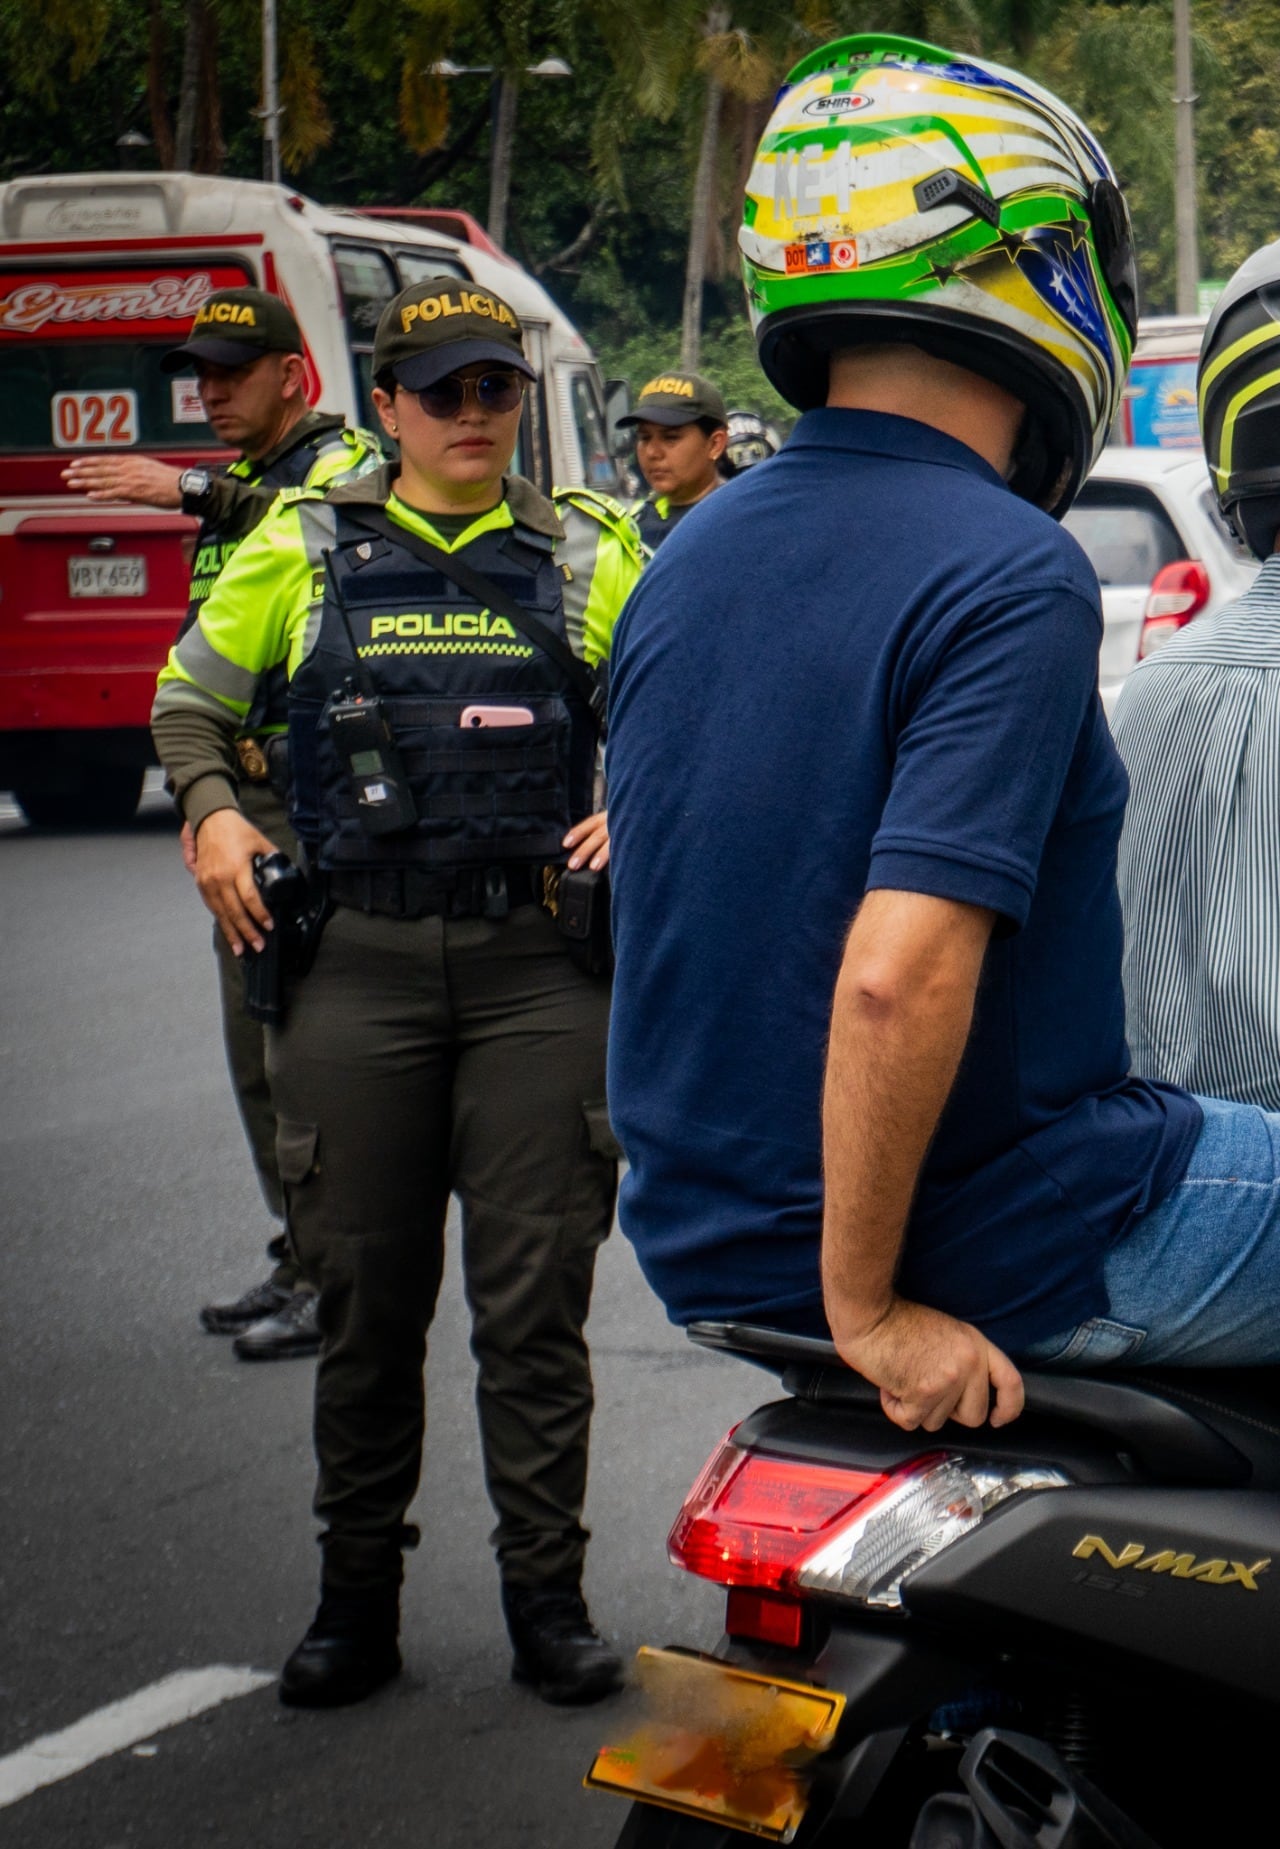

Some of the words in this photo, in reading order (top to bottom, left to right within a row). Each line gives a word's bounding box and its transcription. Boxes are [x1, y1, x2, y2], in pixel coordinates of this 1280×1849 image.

[785, 249, 804, 267] DOT
[4, 273, 206, 324] Ermit
[195, 302, 257, 327] LICIA
[401, 291, 518, 334] POLICIA
[58, 395, 132, 443] 022
[371, 608, 517, 639] POLICÍA
